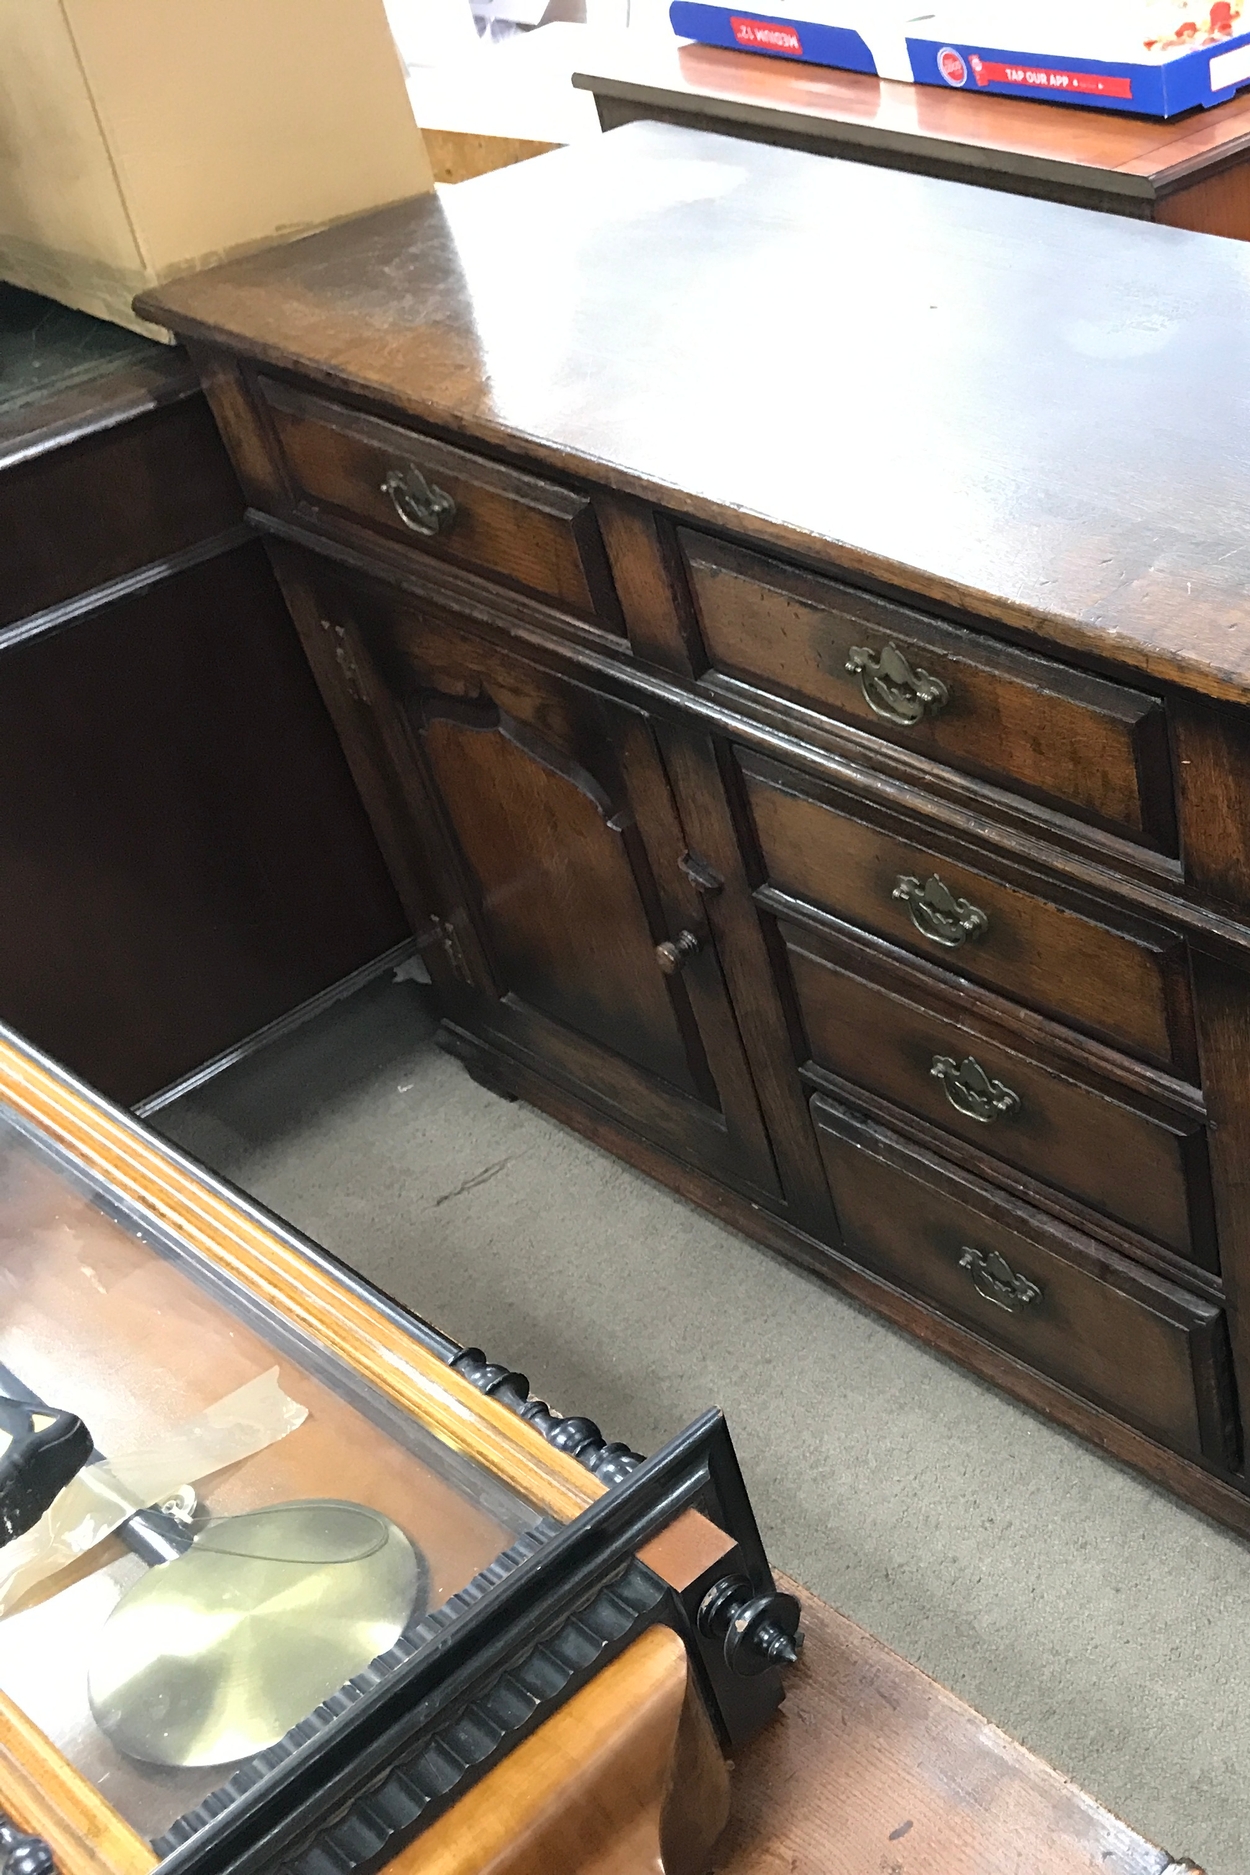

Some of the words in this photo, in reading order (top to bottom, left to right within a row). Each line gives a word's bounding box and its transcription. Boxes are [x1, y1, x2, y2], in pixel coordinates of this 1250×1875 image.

[754, 28, 799, 49] MEDIUM
[1005, 68, 1024, 81] TAP
[1026, 71, 1048, 85] OUR
[1049, 74, 1069, 87] APP
